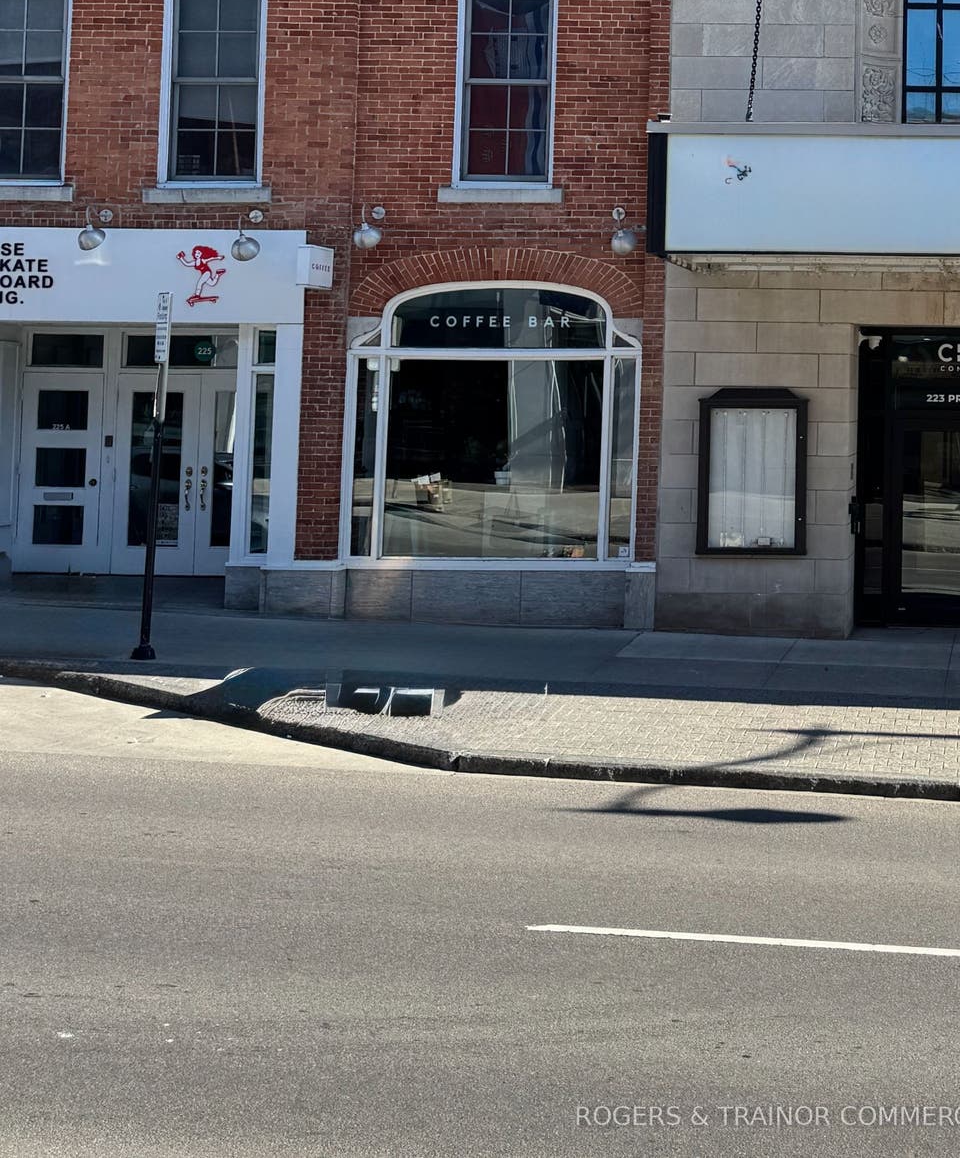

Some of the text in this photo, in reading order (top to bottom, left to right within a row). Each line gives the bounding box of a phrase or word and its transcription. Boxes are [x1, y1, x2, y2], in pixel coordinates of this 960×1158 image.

[0, 243, 24, 256] SE
[0, 259, 48, 272] KATE
[0, 275, 54, 288] OARD
[430, 316, 570, 328] COFFEE BAR
[197, 347, 212, 355] 225
[926, 394, 945, 403] 223
